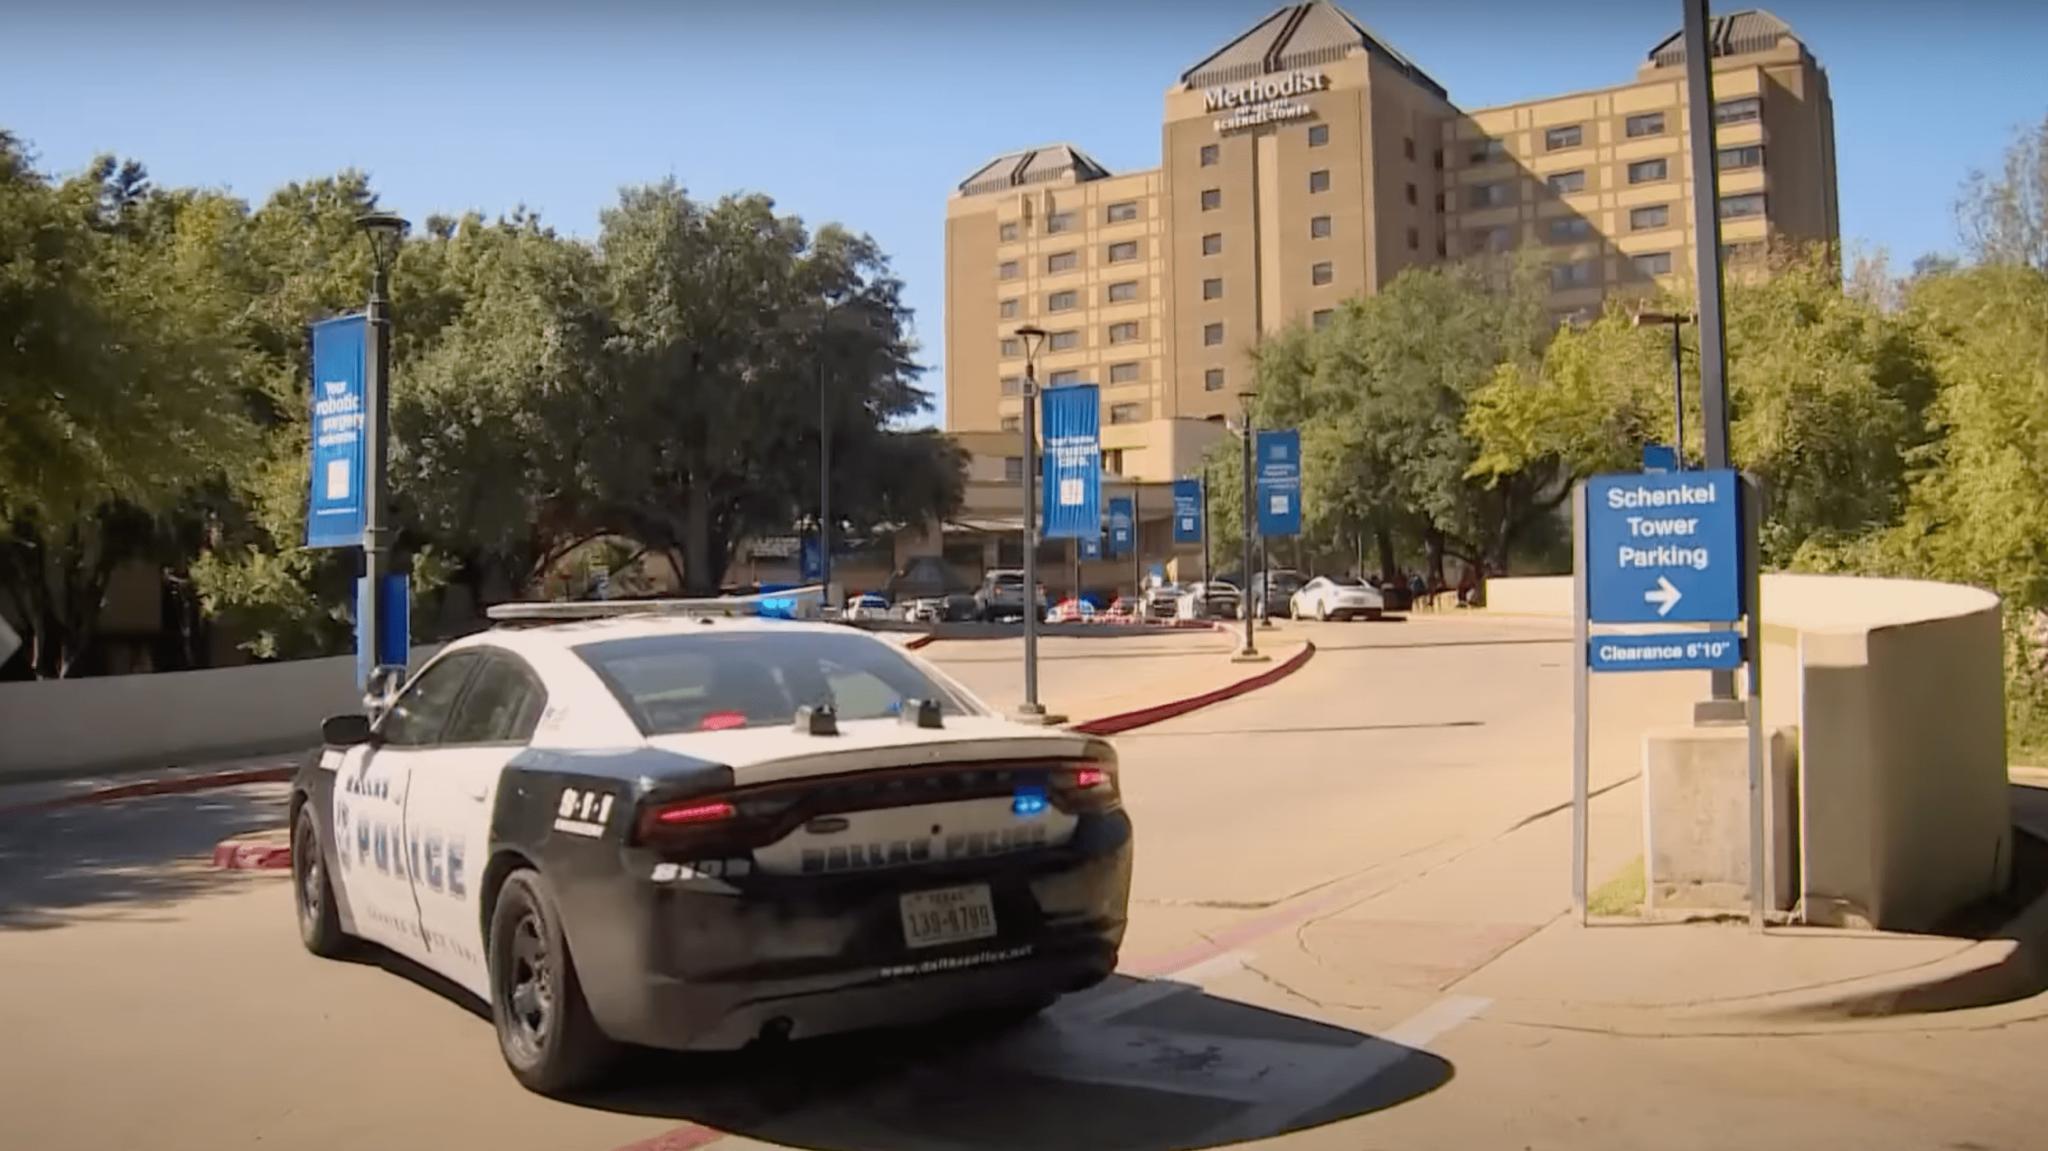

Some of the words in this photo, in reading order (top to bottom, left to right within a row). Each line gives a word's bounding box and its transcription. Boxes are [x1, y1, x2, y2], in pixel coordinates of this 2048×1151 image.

[1203, 71, 1323, 110] Methodist
[1607, 482, 1717, 509] Schenkel
[1626, 516, 1699, 538] Tower
[1618, 545, 1709, 571] Parking
[1599, 644, 1683, 661] Clearance
[1686, 640, 1731, 659] 6'10"
[356, 818, 467, 902] POLICE
